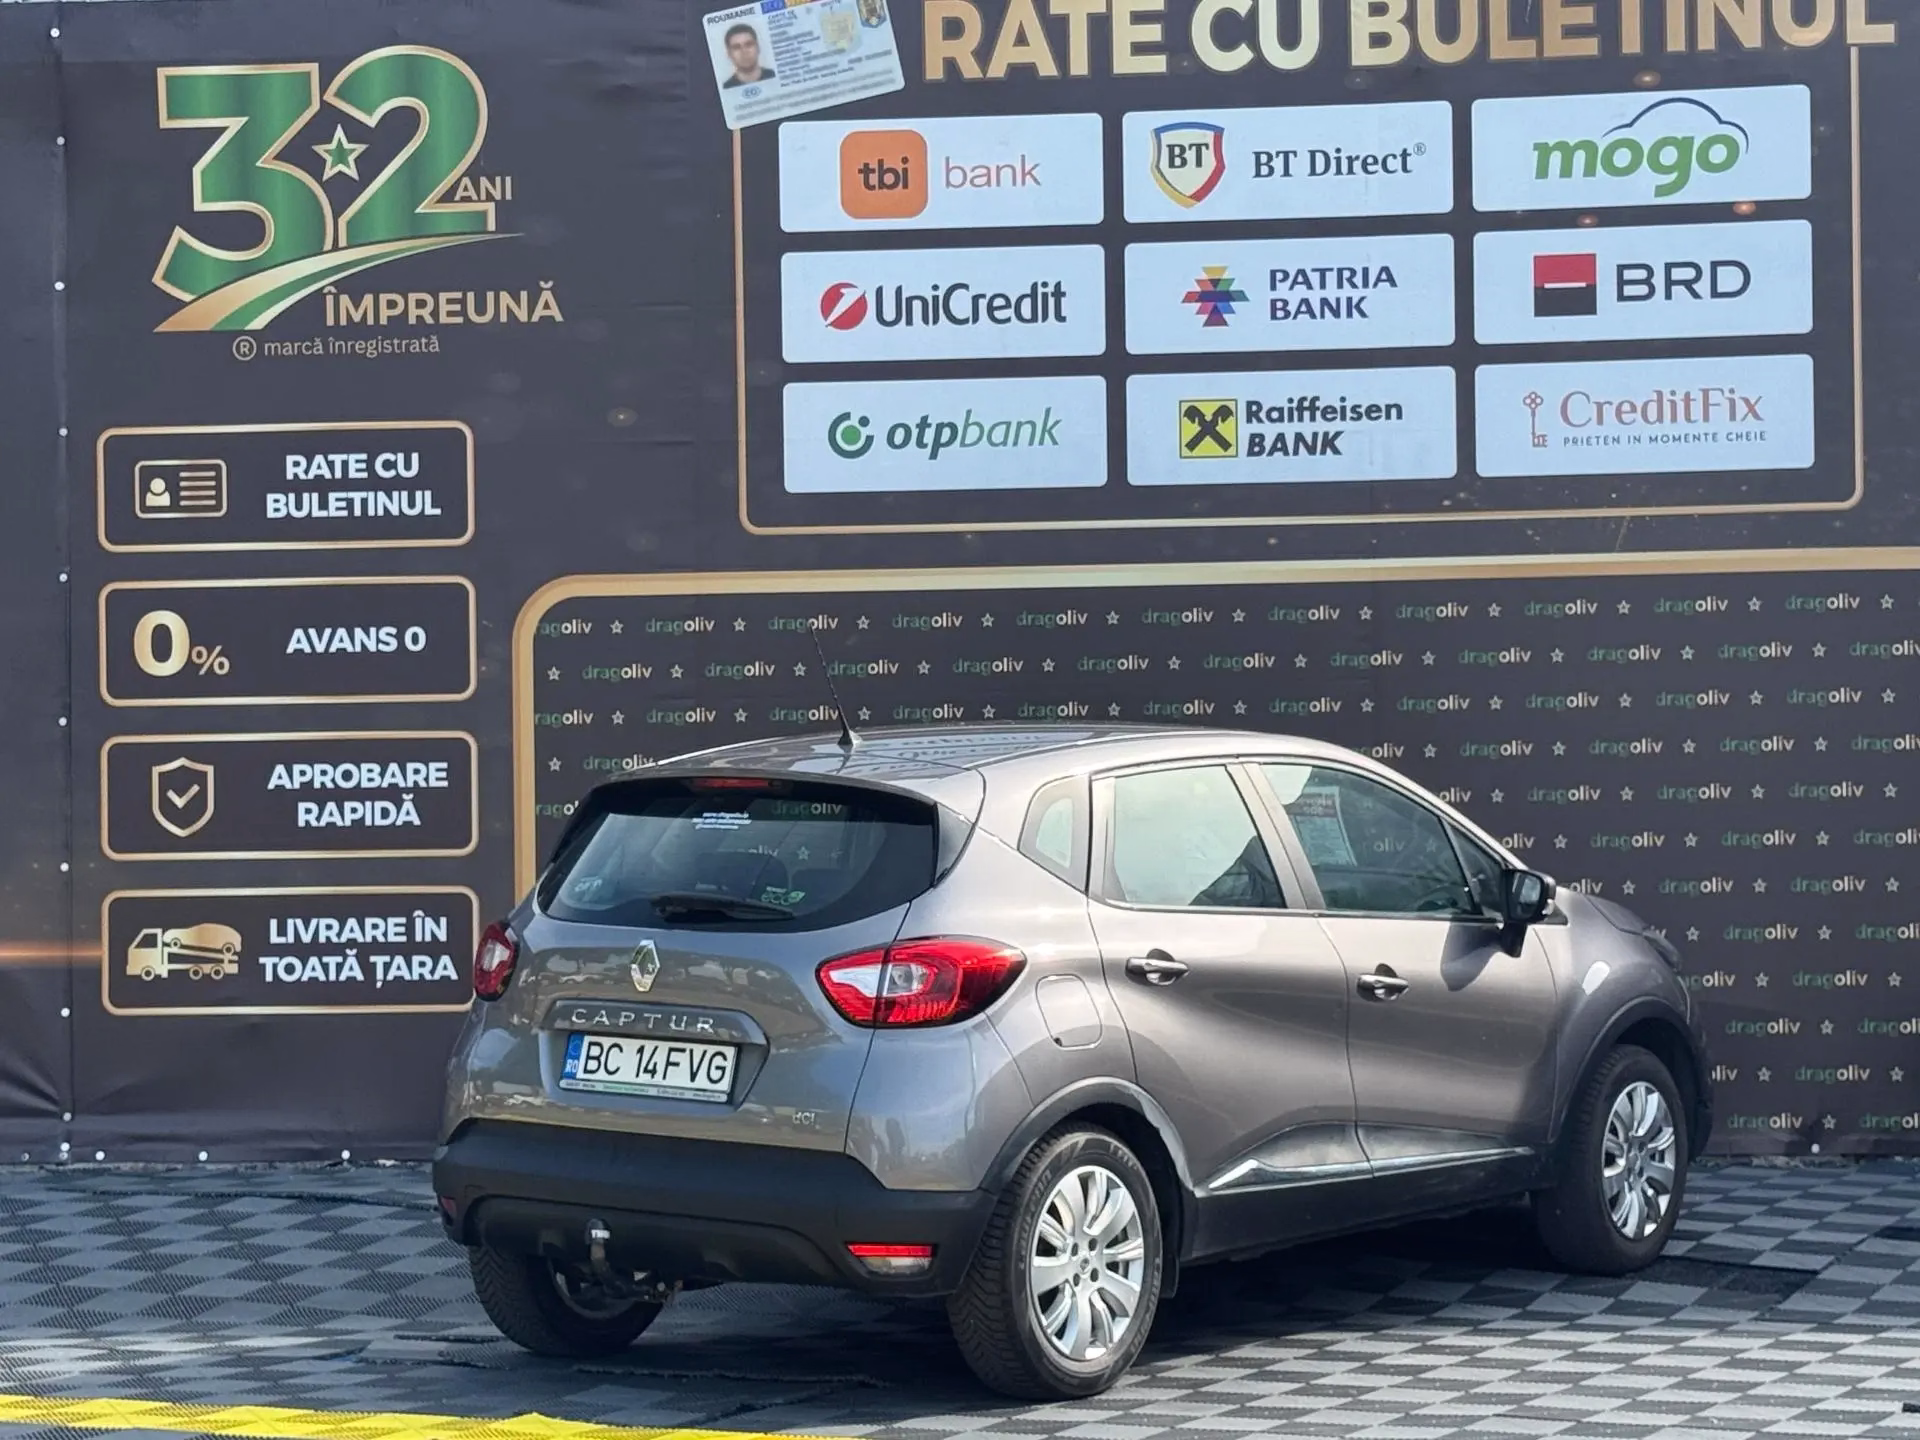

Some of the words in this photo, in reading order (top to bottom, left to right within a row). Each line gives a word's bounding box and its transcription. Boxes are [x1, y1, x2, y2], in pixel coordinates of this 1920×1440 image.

[923, 0, 1168, 81] RATE
[1191, 0, 1321, 72] CU
[1165, 143, 1210, 170] BT
[1252, 151, 1298, 179] BT
[1532, 133, 1741, 198] mogo
[152, 44, 496, 303] 32
[454, 175, 513, 203] ANI
[858, 156, 910, 191] tbi
[944, 154, 1042, 189] bank
[1269, 266, 1398, 292] PATRIA
[1616, 260, 1752, 303] BRD
[324, 281, 564, 327] ÎMPREUNĂ
[875, 281, 1067, 328] UniCredit
[1270, 295, 1368, 321] BANK
[264, 337, 324, 357] marcă
[328, 335, 441, 359] înregistrată
[1245, 395, 1403, 425] Raiffeisen
[1559, 387, 1764, 428] CreditFix
[886, 407, 1062, 460] otpbank
[1246, 430, 1344, 458] BANK
[1564, 434, 1621, 447] PRIETEN
[1627, 434, 1642, 446] IN
[1648, 431, 1718, 445] MOMENTE
[1726, 430, 1767, 442] CHEIE
[286, 453, 368, 481] RATE
[374, 452, 420, 479] CU
[266, 489, 441, 519] BULETINUL
[646, 616, 715, 635] dragoliv
[768, 614, 838, 633] dragoliv
[892, 612, 963, 631] dragoliv
[1017, 609, 1088, 628] dragoliv
[1142, 607, 1214, 626] dragoliv
[1268, 605, 1340, 624] dragoliv
[1396, 602, 1468, 621] dragoliv
[1525, 599, 1598, 618] dragoliv
[1654, 596, 1728, 616] dragoliv
[1786, 593, 1860, 612] dragoliv
[133, 610, 230, 677] 0%
[286, 626, 398, 654] AVANS
[404, 625, 427, 652] 0
[582, 663, 652, 682] dragoliv
[705, 661, 775, 680] dragoliv
[828, 659, 900, 678] dragoliv
[953, 657, 1023, 676] dragoliv
[1078, 655, 1149, 674] dragoliv
[1204, 652, 1275, 671] dragoliv
[1331, 650, 1403, 669] dragoliv
[1459, 647, 1531, 666] dragoliv
[1588, 644, 1661, 663] dragoliv
[1718, 641, 1792, 661] dragoliv
[647, 707, 716, 726] dragoliv
[770, 705, 839, 724] dragoliv
[894, 704, 964, 721] dragoliv
[1018, 701, 1089, 719] dragoliv
[1144, 699, 1215, 718] dragoliv
[1269, 697, 1342, 716] dragoliv
[1397, 694, 1470, 713] dragoliv
[1526, 692, 1599, 711] dragoliv
[1656, 689, 1730, 708] dragoliv
[1787, 687, 1862, 706] dragoliv
[1460, 740, 1533, 759] dragoliv
[1589, 738, 1663, 757] dragoliv
[1720, 735, 1794, 755] dragoliv
[267, 761, 449, 790] APROBARE
[1528, 785, 1601, 804] dragoliv
[1658, 783, 1732, 802] dragoliv
[1789, 781, 1864, 800] dragoliv
[297, 793, 421, 828] RAPIDĂ
[1591, 832, 1665, 851] dragoliv
[1721, 829, 1796, 849] dragoliv
[1660, 877, 1734, 896] dragoliv
[1791, 876, 1866, 895] dragoliv
[269, 918, 407, 944] LIVRARE
[412, 910, 448, 942] ÎN
[1724, 923, 1798, 942] dragoliv
[259, 950, 363, 984] TOATĂ
[374, 955, 459, 989] ȚARA
[1793, 970, 1868, 989] dragoliv
[571, 1009, 715, 1034] CAPTUR
[1726, 1018, 1800, 1037] dragoliv
[565, 1059, 579, 1074] RO
[583, 1041, 624, 1077] BC
[1795, 1064, 1870, 1084] dragoliv
[1728, 1112, 1803, 1131] dragoliv
